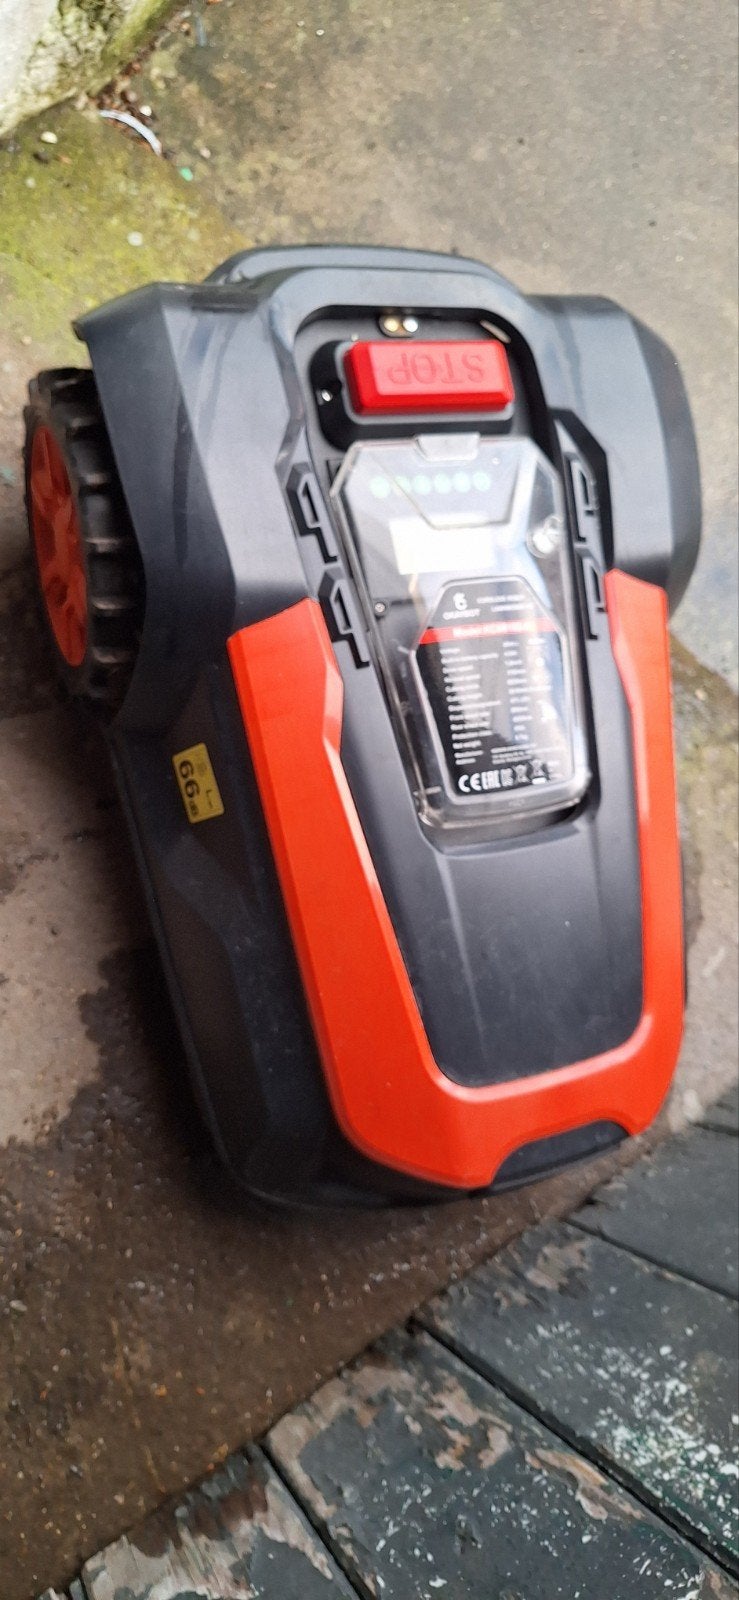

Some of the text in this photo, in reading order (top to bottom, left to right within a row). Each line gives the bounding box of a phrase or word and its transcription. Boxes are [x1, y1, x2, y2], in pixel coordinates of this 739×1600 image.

[386, 352, 485, 385] STOP
[179, 760, 200, 798] 66
[458, 773, 482, 793] CE
